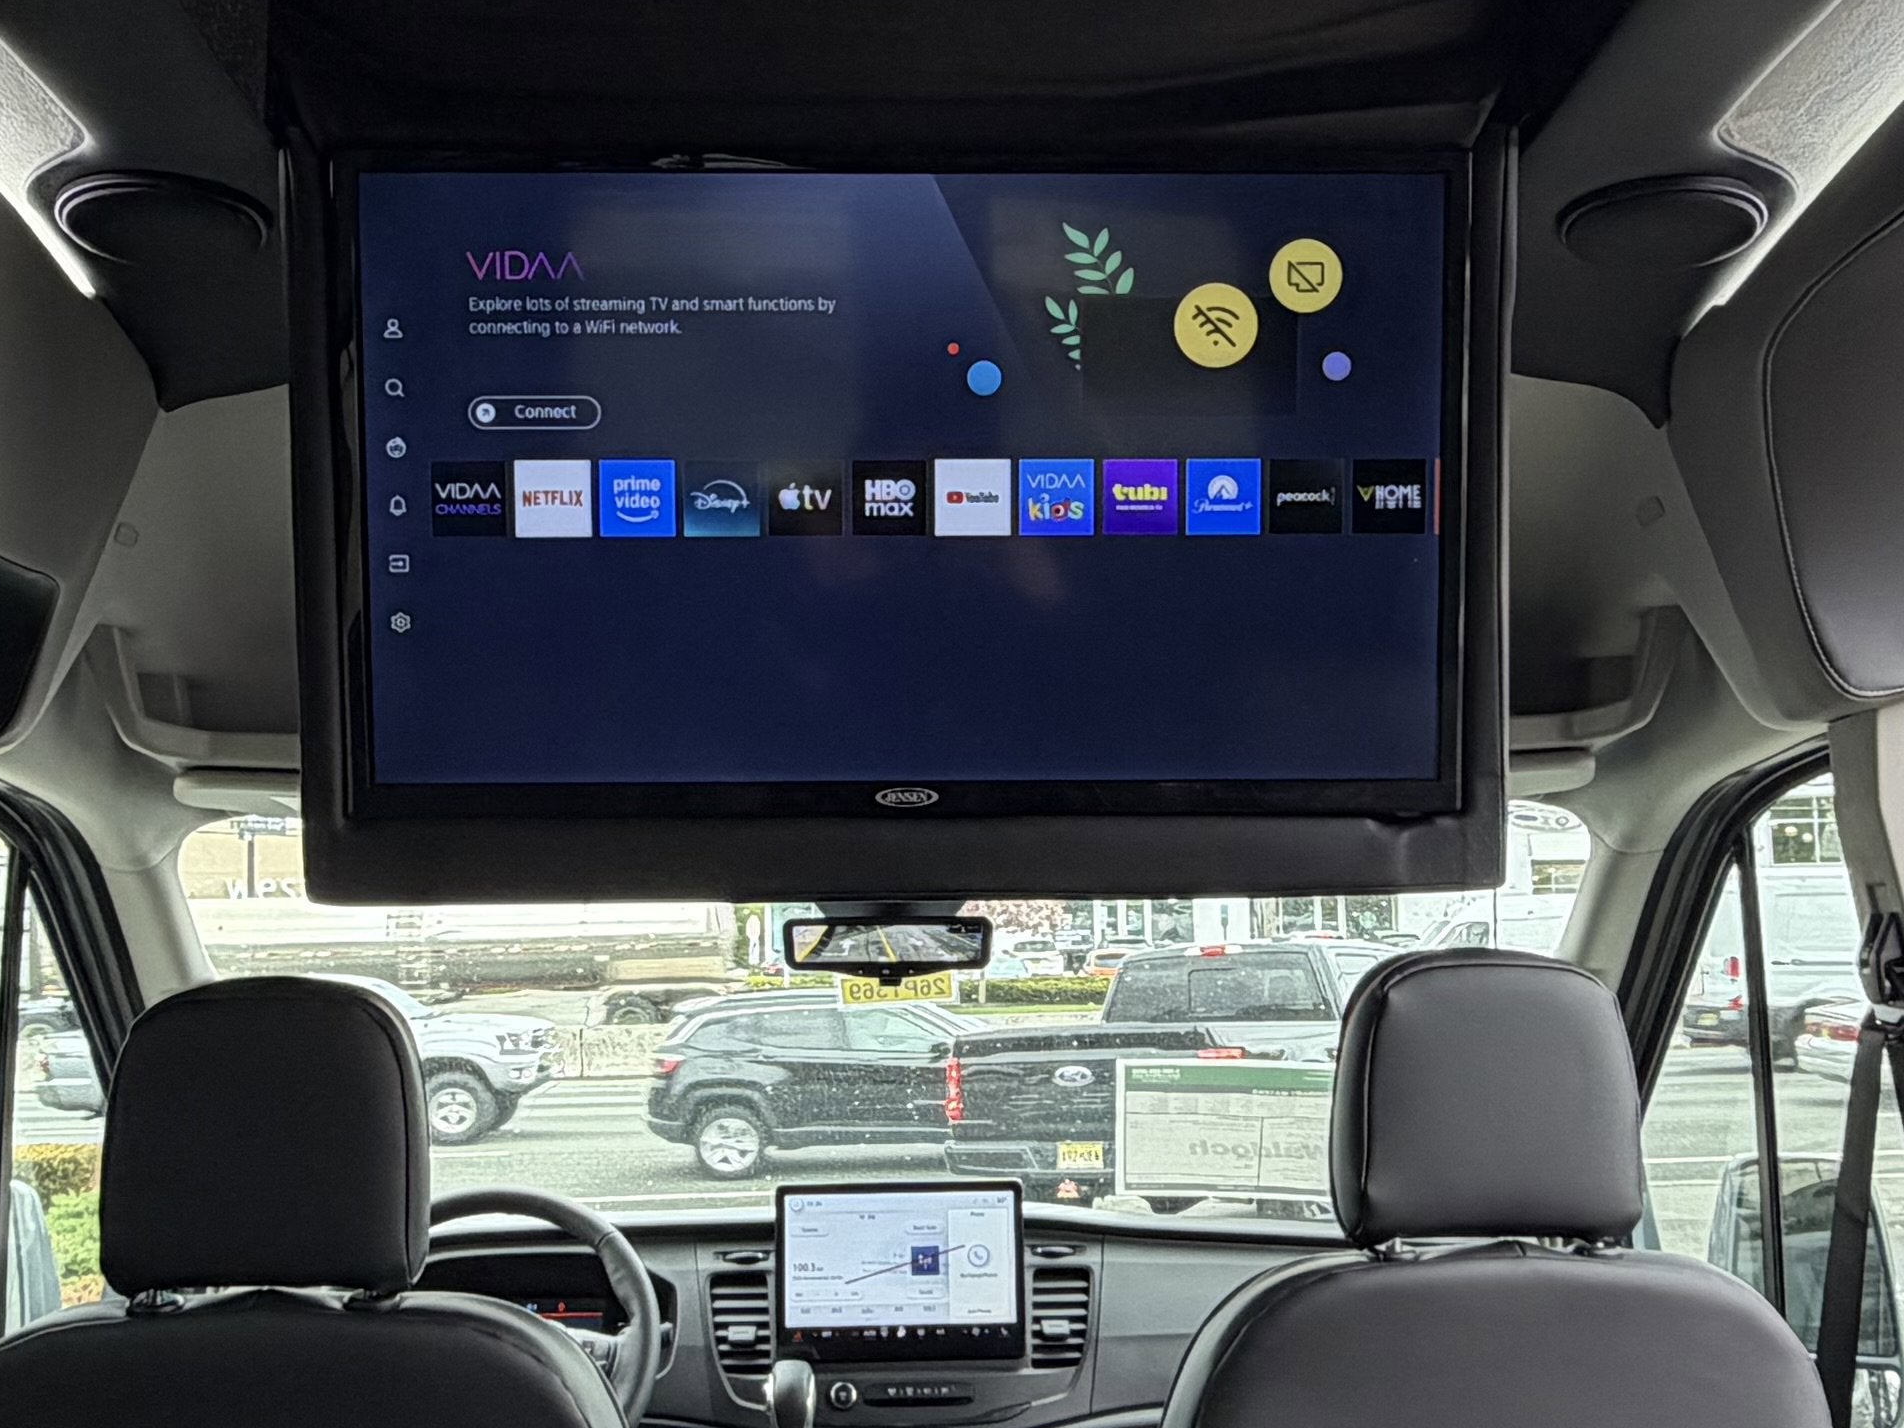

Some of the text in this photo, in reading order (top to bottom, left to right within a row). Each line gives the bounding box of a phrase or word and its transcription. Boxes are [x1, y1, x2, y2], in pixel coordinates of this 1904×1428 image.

[465, 250, 585, 281] VIDAA
[468, 295, 837, 315] Explore lots of streaming TV and smart functions by
[468, 318, 683, 338] connecting to a WiFi network.
[513, 403, 577, 421] Connect
[612, 475, 662, 495] prime
[863, 478, 917, 502] HBO
[1026, 472, 1086, 489] VIDAA
[434, 482, 502, 501] VIDAA
[522, 489, 584, 508] NETFLIX
[614, 491, 661, 509] video
[802, 484, 833, 511] tv
[965, 491, 1000, 504] YouTube
[1112, 483, 1169, 502] tubi
[1276, 489, 1330, 507] peacock
[434, 503, 502, 516] CHANNELS
[863, 500, 915, 517] max
[1027, 492, 1085, 522] kids
